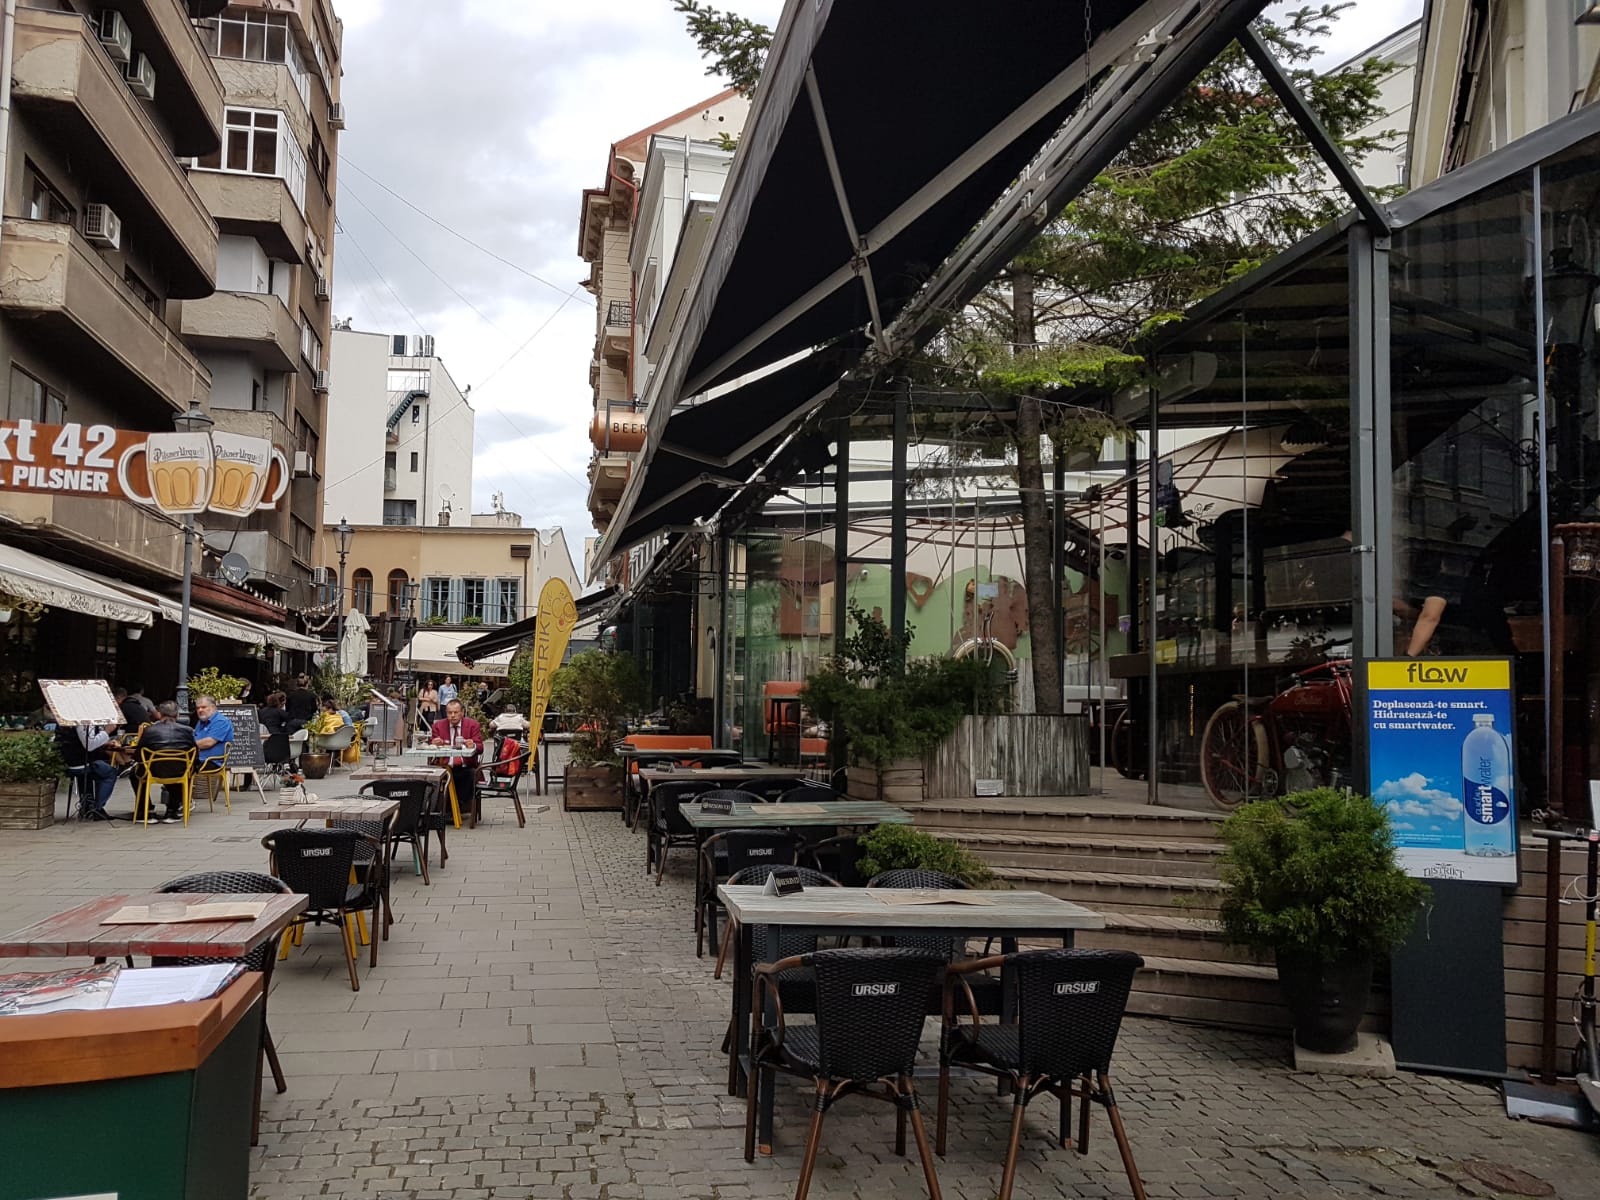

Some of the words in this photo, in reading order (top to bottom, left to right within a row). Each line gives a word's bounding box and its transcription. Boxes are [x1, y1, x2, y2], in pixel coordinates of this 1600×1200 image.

[613, 423, 647, 434] BEER
[52, 423, 117, 468] 42
[215, 445, 240, 460] Pilsner
[153, 447, 179, 463] Pilsner
[12, 465, 109, 492] PILSNER
[535, 604, 552, 718] DISTRIKT
[1406, 662, 1468, 684] flow
[1450, 700, 1488, 709] smart.
[1388, 721, 1456, 730] smartwater.
[854, 984, 896, 996] URSUS
[1056, 982, 1098, 994] URSUS
